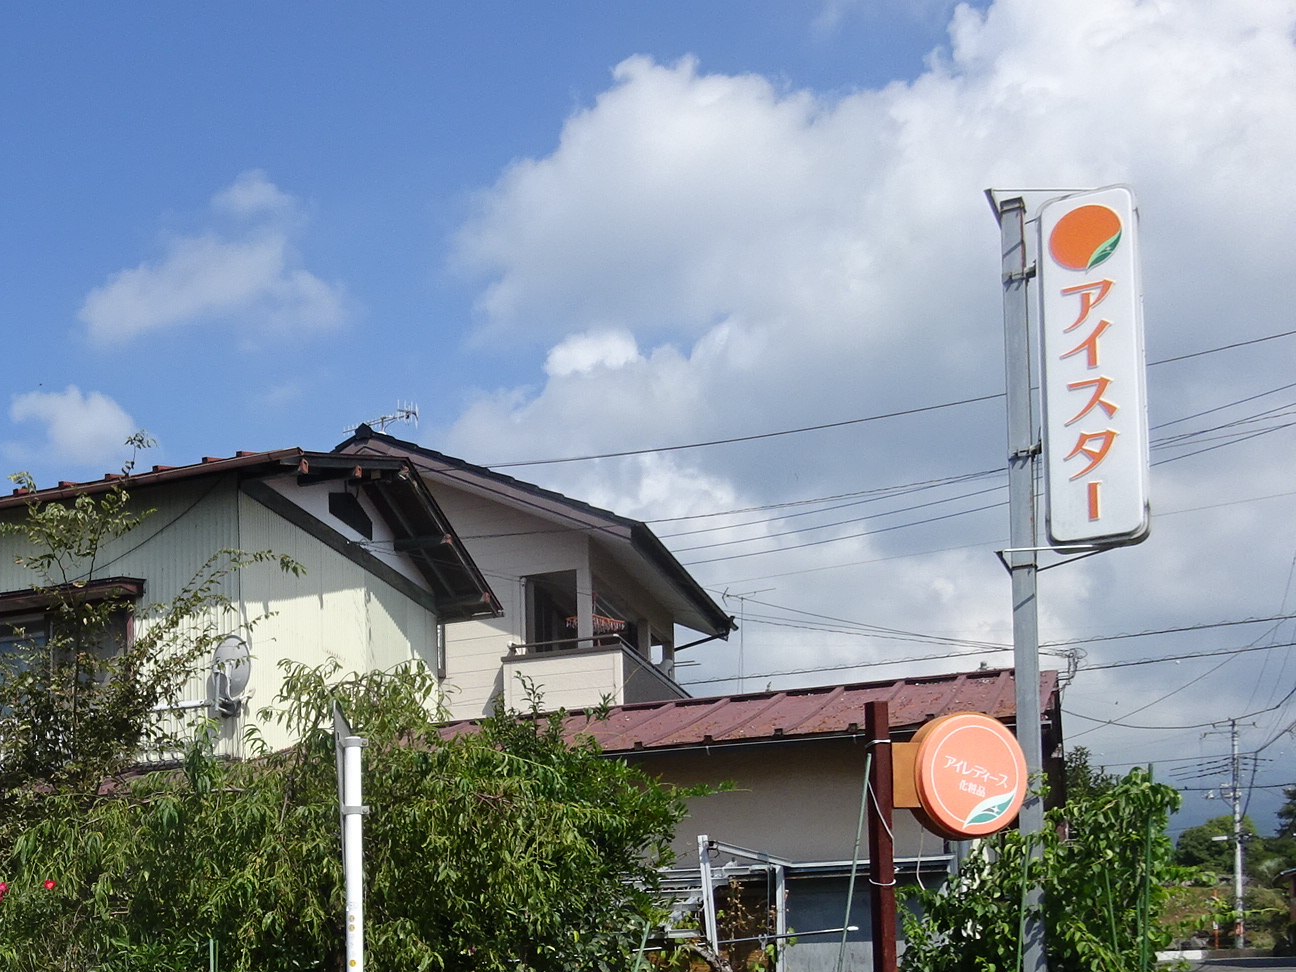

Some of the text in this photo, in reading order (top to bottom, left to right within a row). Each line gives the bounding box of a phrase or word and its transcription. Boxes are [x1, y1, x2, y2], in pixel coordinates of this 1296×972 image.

[1059, 278, 1120, 522] アイスター
[943, 755, 1009, 789] アイレディース
[958, 779, 987, 798] 化粧品
